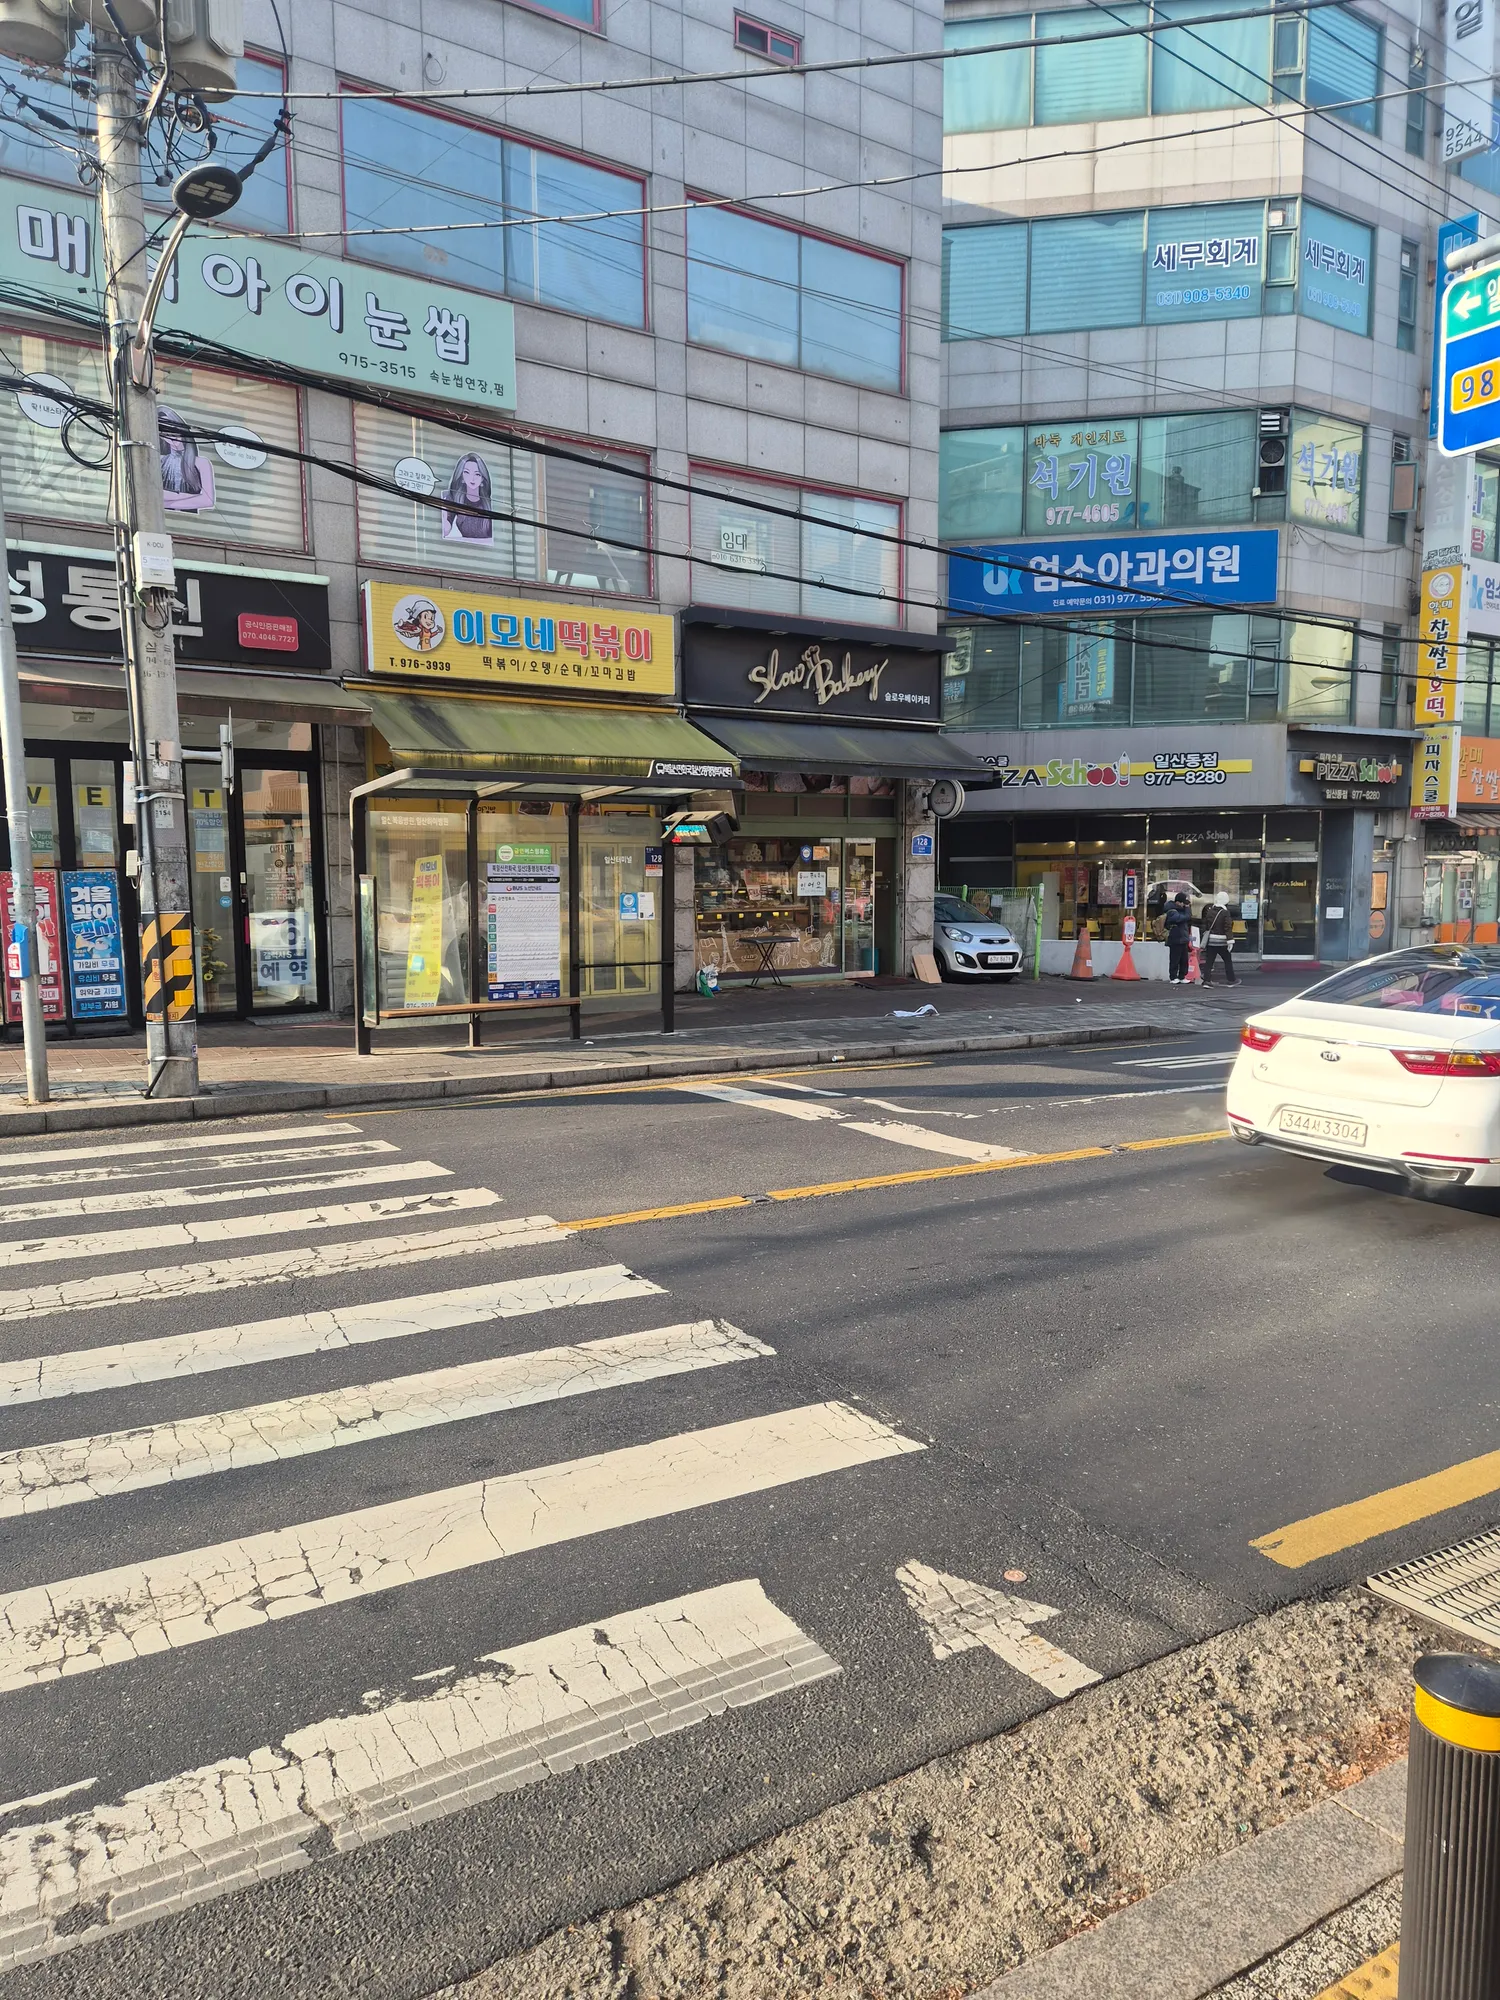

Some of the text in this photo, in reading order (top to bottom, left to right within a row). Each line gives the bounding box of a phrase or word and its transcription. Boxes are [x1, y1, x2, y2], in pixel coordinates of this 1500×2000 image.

[1445, 131, 1483, 157] 5544
[1153, 236, 1259, 273] 세무회계
[1305, 238, 1365, 287] 세무회계
[16, 205, 471, 365] 매아이눈썹
[339, 352, 504, 397] 975-3515 속눈썹연장,펌
[1035, 430, 1127, 449] 바둑 개인지도
[1030, 453, 1133, 500] 석기원
[1296, 442, 1359, 494] 석기원
[1046, 503, 1120, 526] 977-4605
[722, 531, 748, 551] 임대
[1028, 543, 1241, 594] 엄소아과의원
[1094, 595, 1115, 605] 031)
[453, 608, 653, 662] 이모네떡볶이
[400, 658, 451, 672] 976-3939
[748, 649, 803, 704] Slow
[803, 650, 889, 705] Bakery
[884, 691, 931, 705] 슬로우베이커리
[1046, 751, 1131, 787] School
[1154, 752, 1219, 769] 일산동점
[1316, 754, 1397, 784] PIZZA School
[1144, 770, 1226, 785] 977-8280
[1424, 744, 1440, 803] 피자스쿨
[86, 787, 103, 806] E
[199, 789, 215, 807] T
[1325, 788, 1381, 800] 일산동점 977-8280
[916, 837, 929, 846] 128
[1176, 833, 1204, 841] PIZZA
[650, 854, 662, 863] 128
[70, 886, 112, 903] 겨울
[72, 903, 113, 921] 맞이
[71, 917, 117, 940] 행사
[101, 960, 116, 968] 무료
[80, 987, 118, 996] 위약금 지원
[104, 1001, 119, 1009] 지원
[1322, 1051, 1340, 1062] KIA
[1322, 1121, 1361, 1142] 3304
